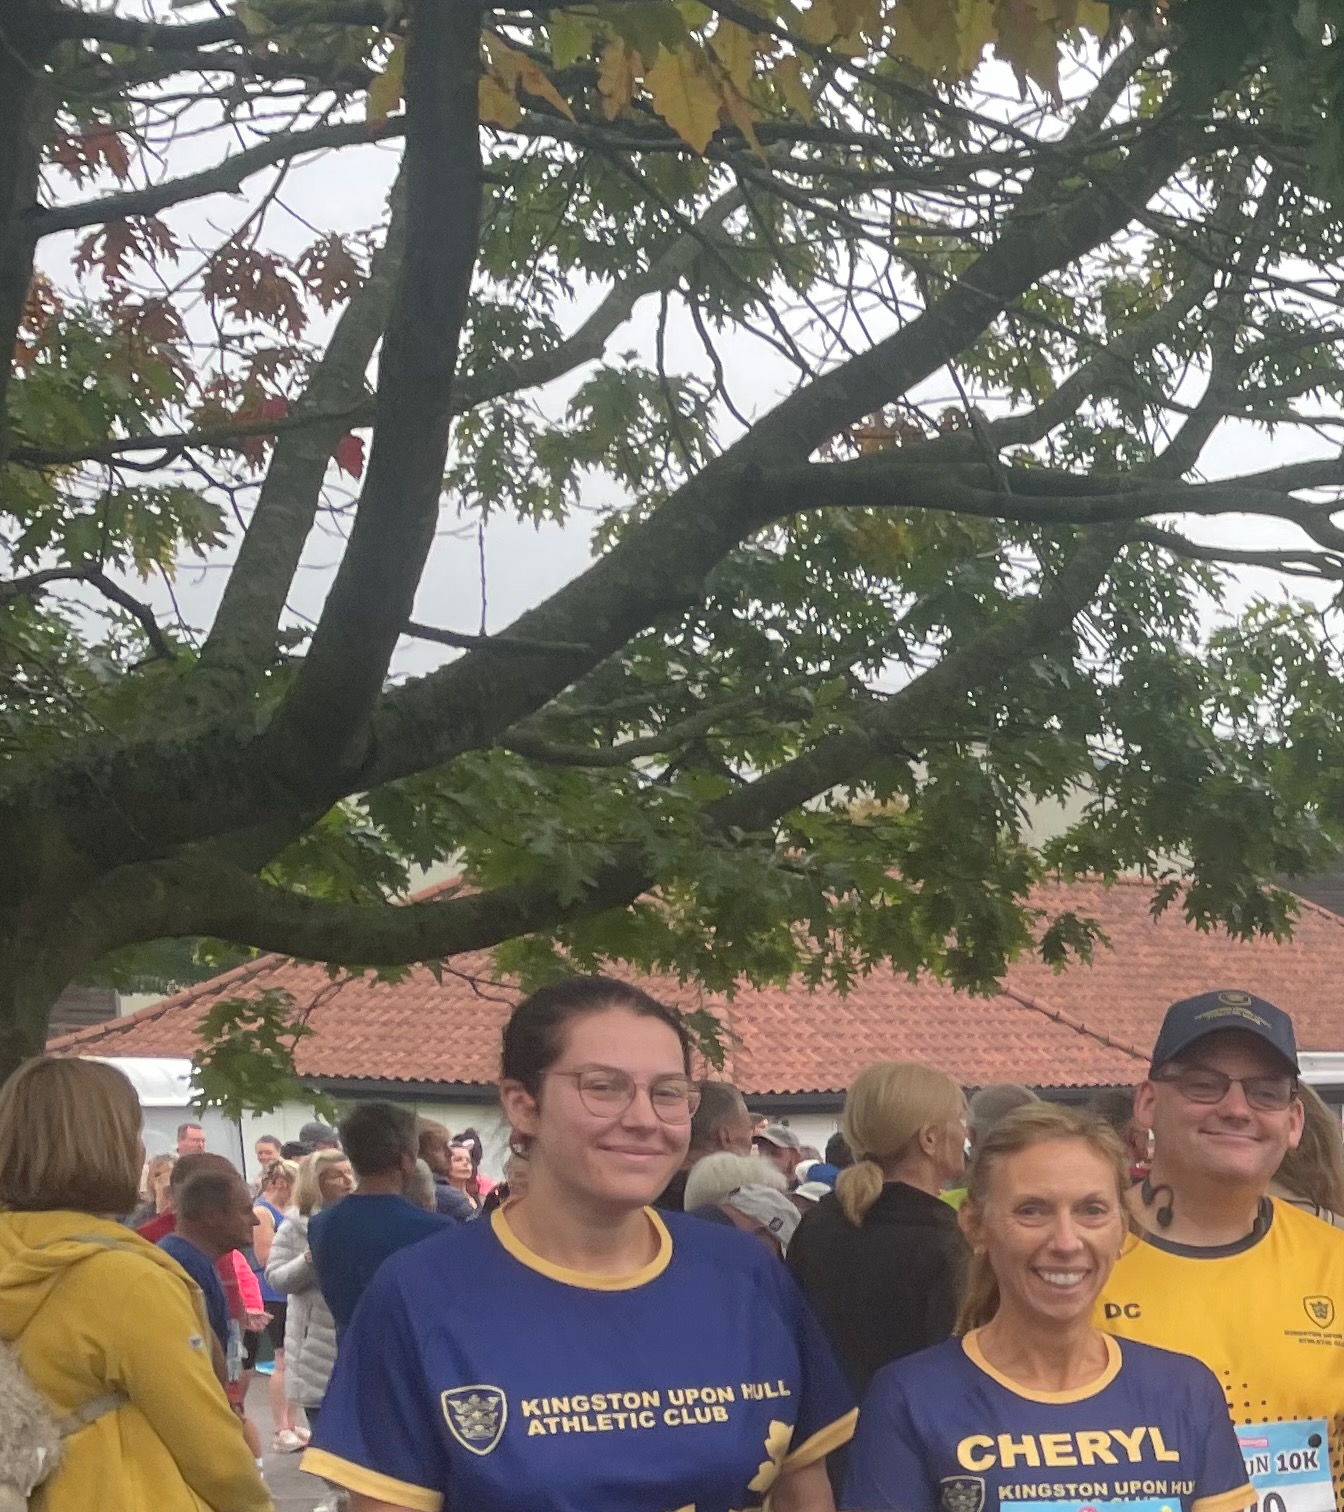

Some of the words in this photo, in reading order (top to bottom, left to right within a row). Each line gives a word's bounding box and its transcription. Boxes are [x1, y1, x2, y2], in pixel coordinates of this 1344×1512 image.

[1104, 1303, 1141, 1319] DC
[521, 1390, 661, 1417] KINGSTON
[667, 1386, 735, 1406] UPON
[740, 1380, 791, 1400] HULL
[527, 1411, 656, 1436] ATHLETIC
[663, 1406, 729, 1426] CLUB
[957, 1427, 1180, 1472] CHERYL
[1277, 1451, 1318, 1472] 10K
[998, 1482, 1109, 1500] KINGSTON
[1115, 1480, 1167, 1495] UPON
[1171, 1480, 1196, 1495] HU
